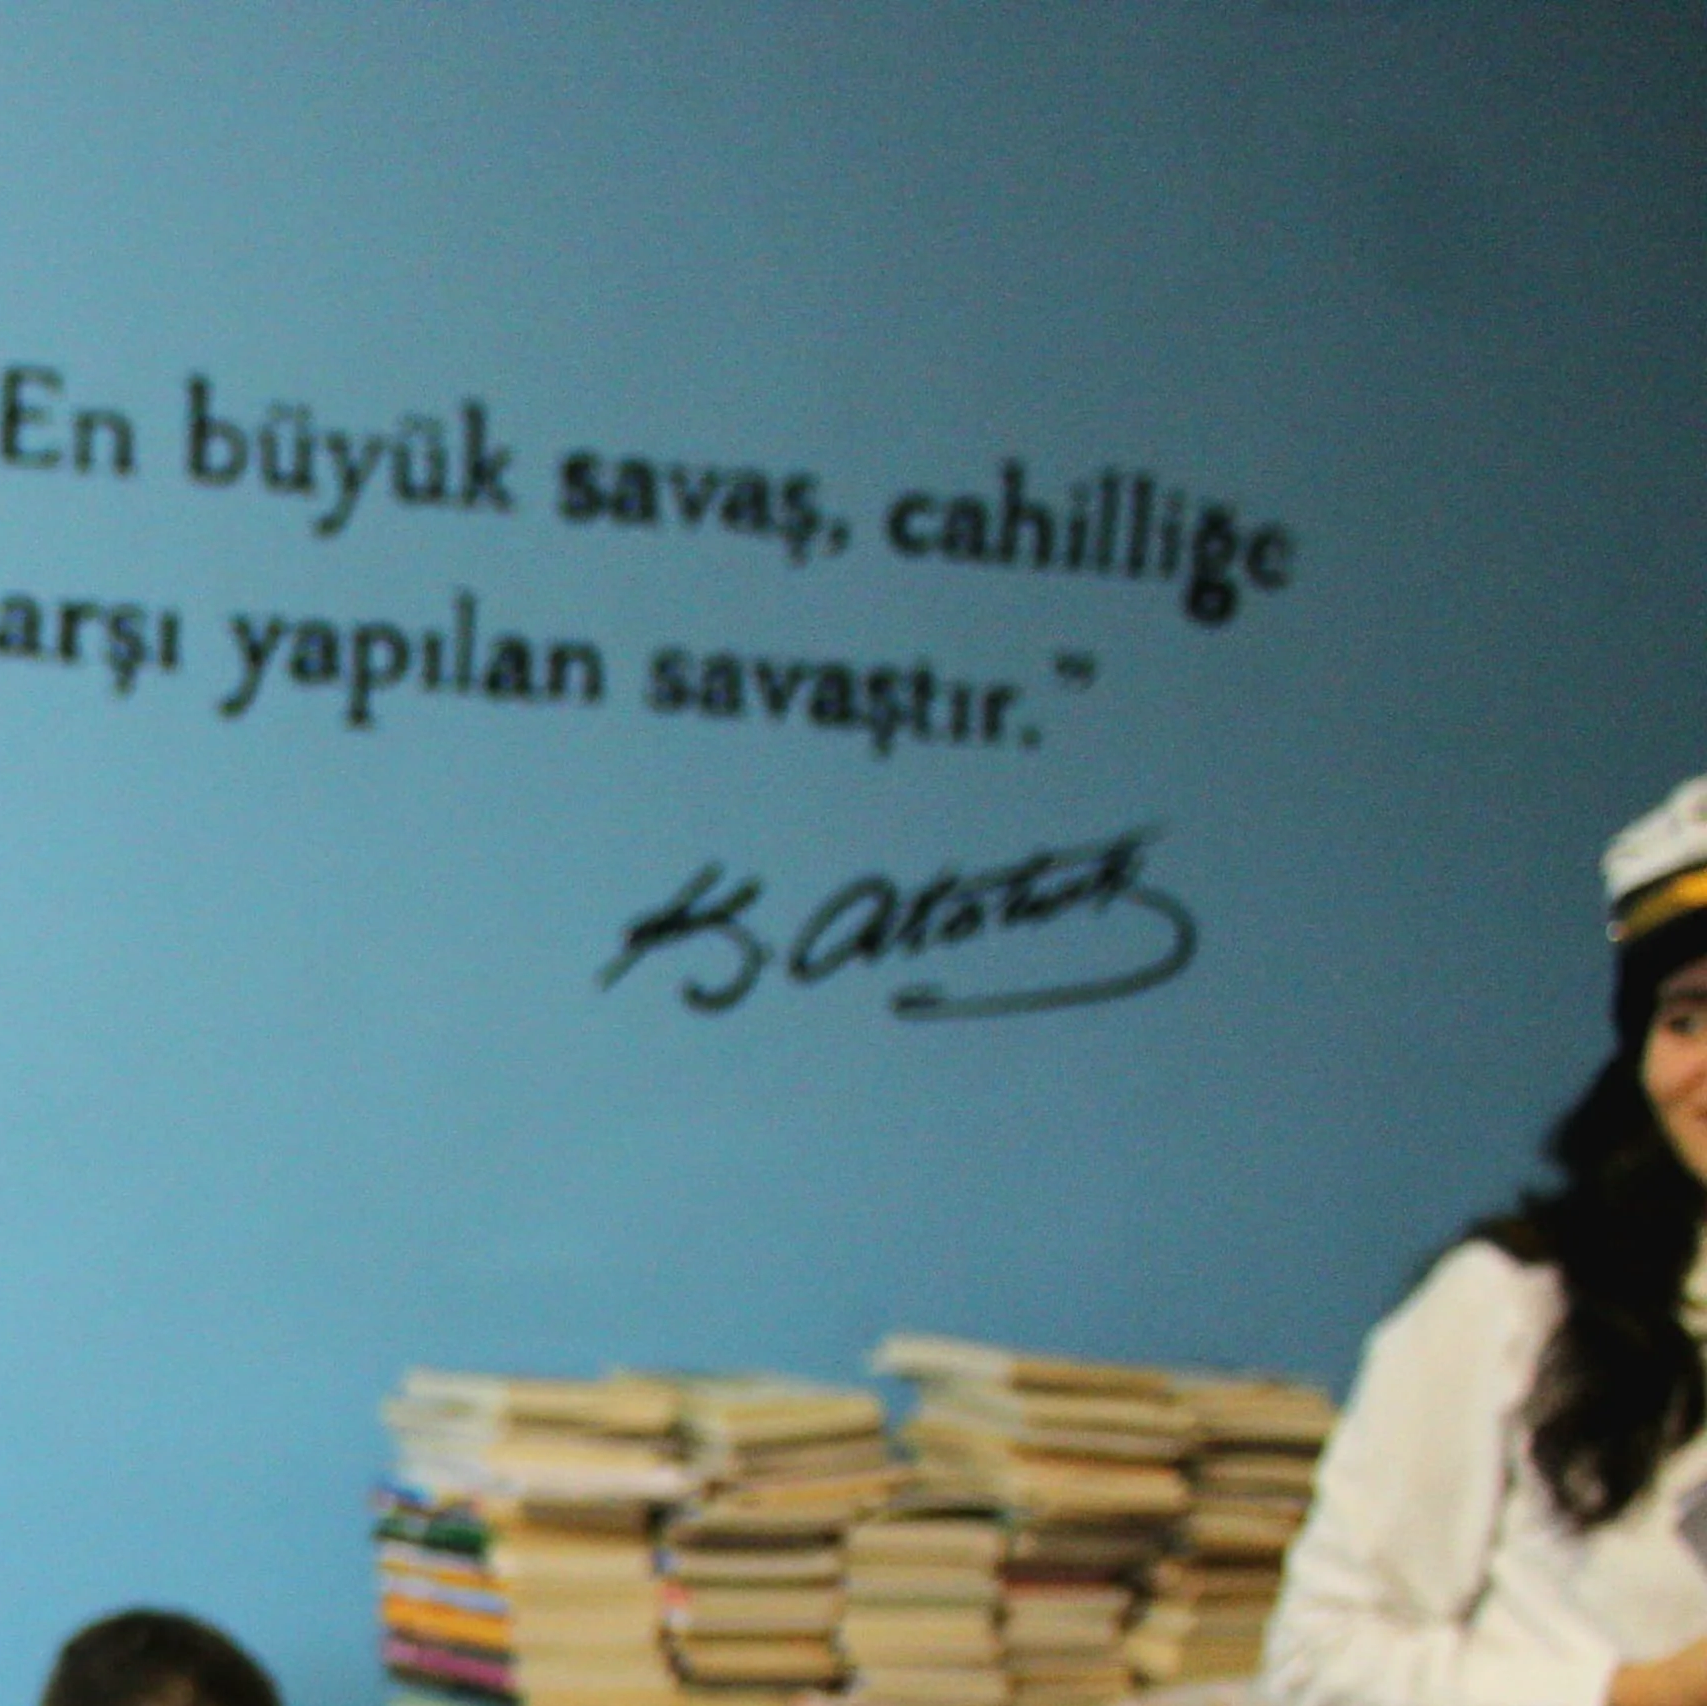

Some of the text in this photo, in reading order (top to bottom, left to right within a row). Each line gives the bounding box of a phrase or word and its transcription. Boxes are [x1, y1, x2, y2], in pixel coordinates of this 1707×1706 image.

[186, 370, 517, 538] büyük
[557, 448, 850, 567] savaş,
[219, 590, 607, 731] yapılan
